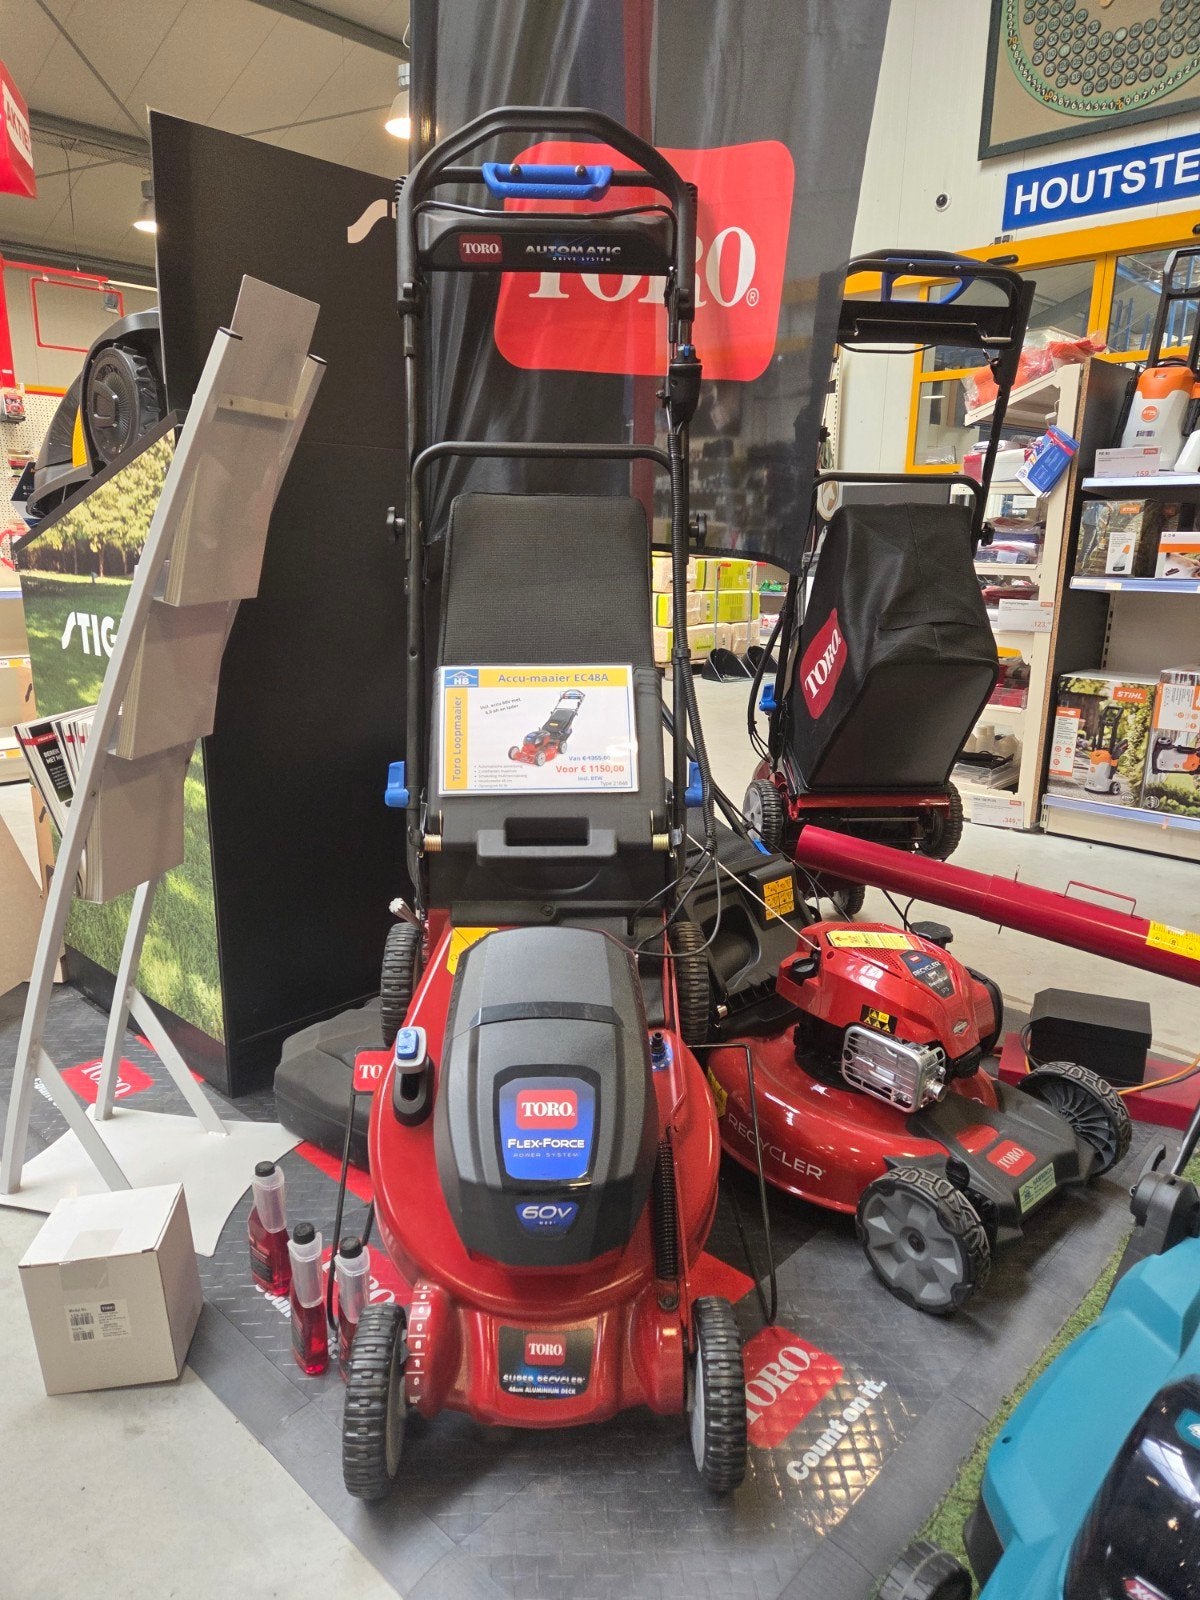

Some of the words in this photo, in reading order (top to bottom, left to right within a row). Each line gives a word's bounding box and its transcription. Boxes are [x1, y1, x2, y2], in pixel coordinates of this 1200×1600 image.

[1014, 148, 1200, 215] HOUTSTE
[463, 243, 499, 254] TORO
[525, 245, 621, 255] AUTOMATIC
[804, 629, 839, 699] TORO
[454, 677, 469, 685] HB
[498, 674, 570, 683] Accu-maaier
[574, 673, 609, 682] EC48A
[1116, 690, 1143, 700] STIHL
[453, 697, 464, 755] Loopmaaier
[453, 758, 461, 781] Toro
[556, 765, 578, 773] Voor
[590, 764, 624, 774] 1150,00
[522, 1102, 573, 1117] TORO
[508, 1138, 585, 1148] FLEX-FORCE
[729, 1113, 823, 1180] RECYCLER
[997, 1147, 1024, 1169] TORO
[522, 1206, 573, 1219] 60V
[529, 1343, 562, 1355] TORO
[503, 1374, 534, 1382] SUPER
[537, 1375, 583, 1385] RECYCLER
[525, 1386, 559, 1394] ALUMINIUM
[787, 1419, 849, 1480] Count
[842, 1396, 871, 1422] on
[857, 1379, 888, 1400] it.
